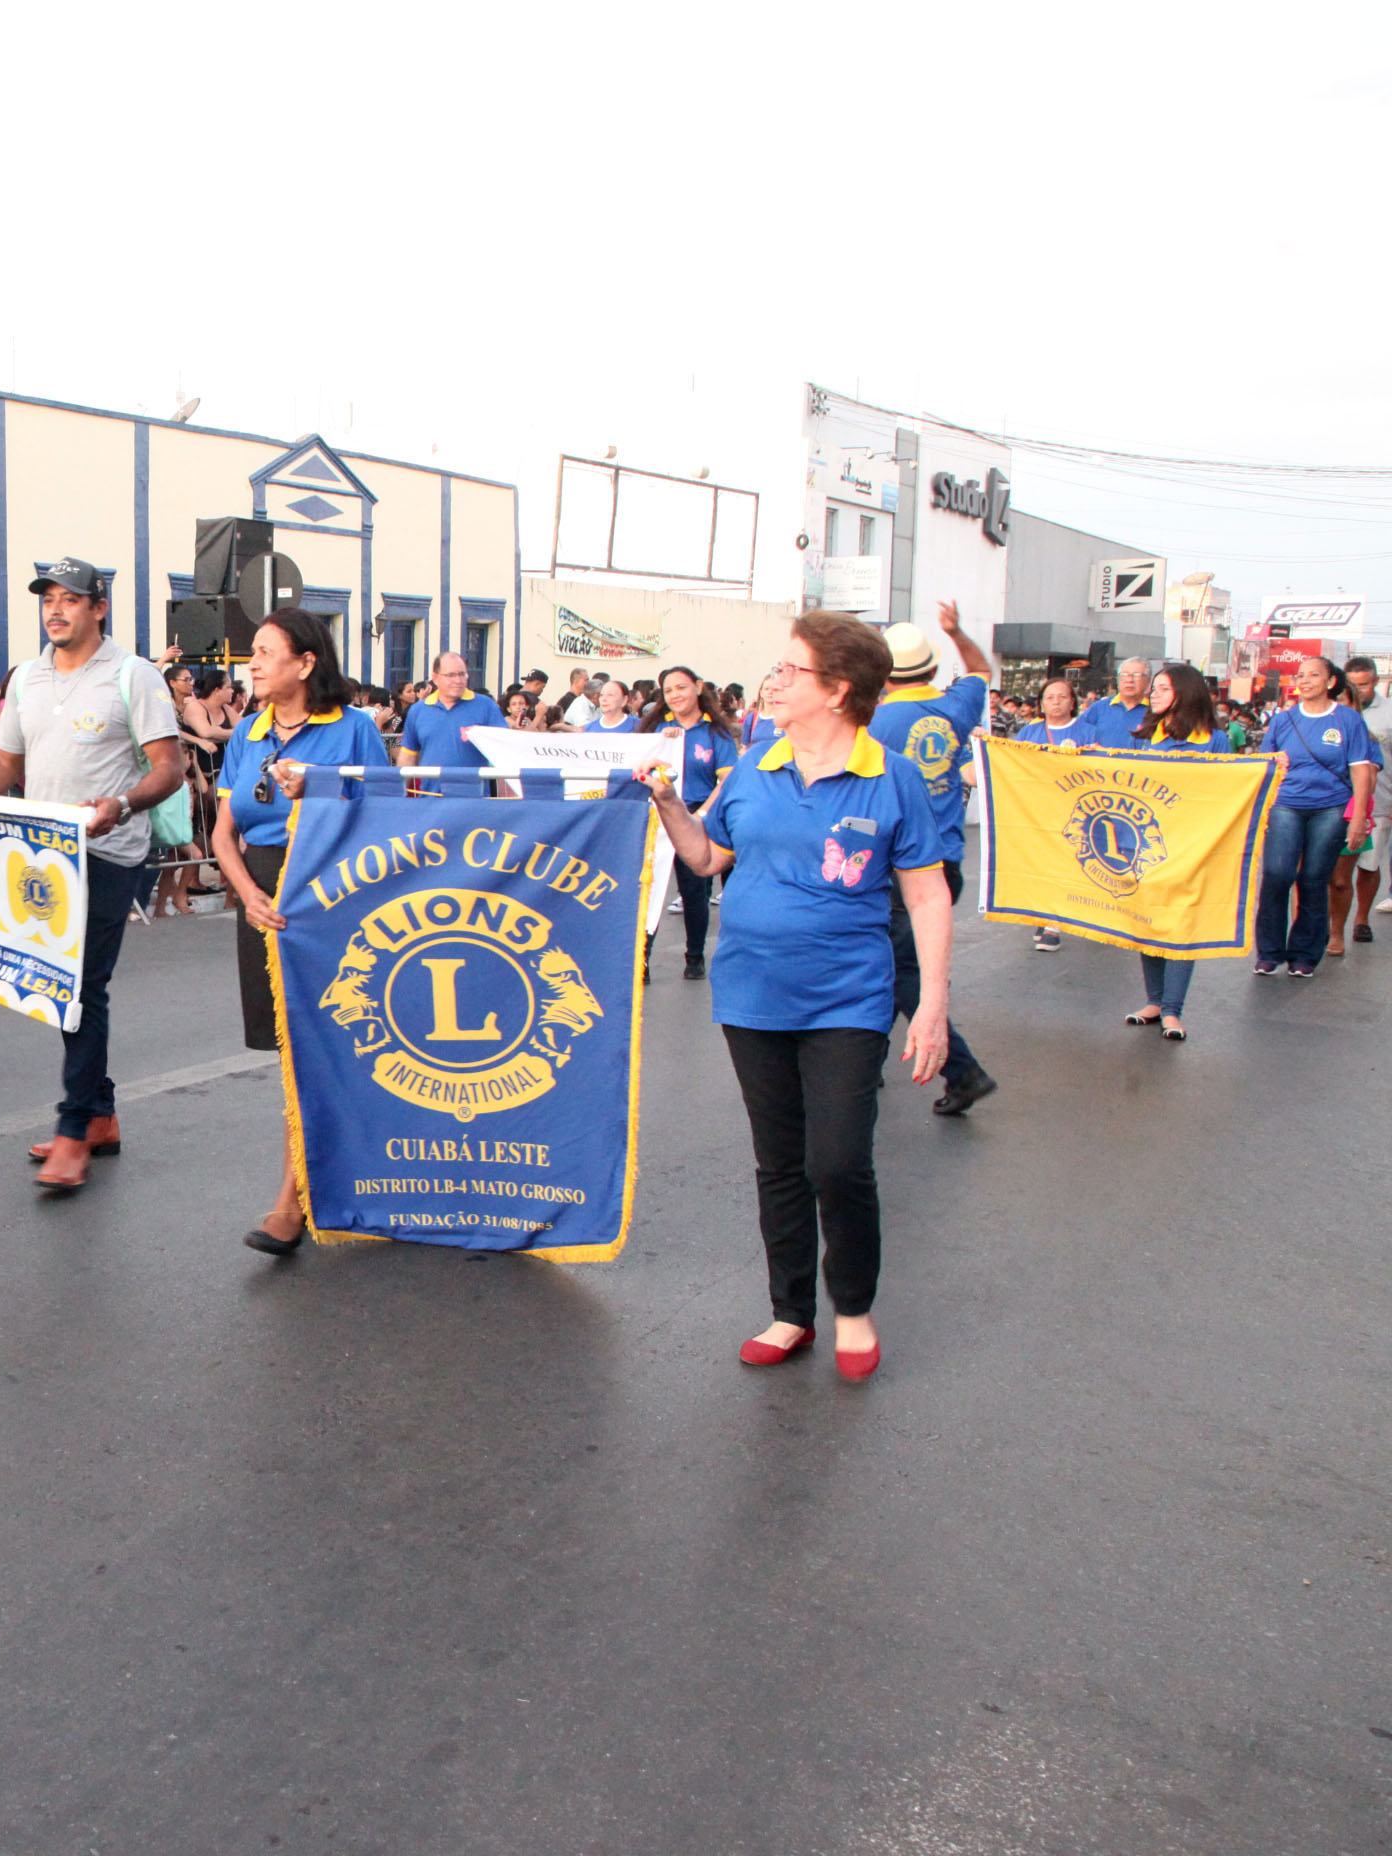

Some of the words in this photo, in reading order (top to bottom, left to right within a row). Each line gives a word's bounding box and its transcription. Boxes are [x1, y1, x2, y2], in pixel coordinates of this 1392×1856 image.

[931, 471, 988, 518] Studio
[1101, 566, 1112, 608] STUDIO
[1272, 604, 1356, 623] GAZIN
[533, 746, 579, 759] LIONS
[584, 749, 626, 764] CLUBE
[926, 736, 942, 759] L
[1055, 768, 1106, 792] LIONS
[1112, 769, 1182, 809] CLUBE
[1083, 795, 1148, 821] LIONS
[28, 828, 79, 855] LEÃO
[307, 828, 448, 912] LIONS
[462, 827, 620, 911] CLUBE
[372, 894, 540, 945] LIONS
[20, 973, 72, 1002] LEÃO
[421, 958, 502, 1040] L
[385, 1060, 543, 1104] INTERNATIONAL
[385, 1134, 474, 1162] CUIABÁ
[478, 1140, 551, 1167] LESTE
[354, 1178, 430, 1195] DISTRITO
[433, 1179, 468, 1194] LB-4
[471, 1180, 518, 1197] MATO
[521, 1183, 586, 1205] GROSSO
[389, 1211, 480, 1229] FUNDAÇÃO
